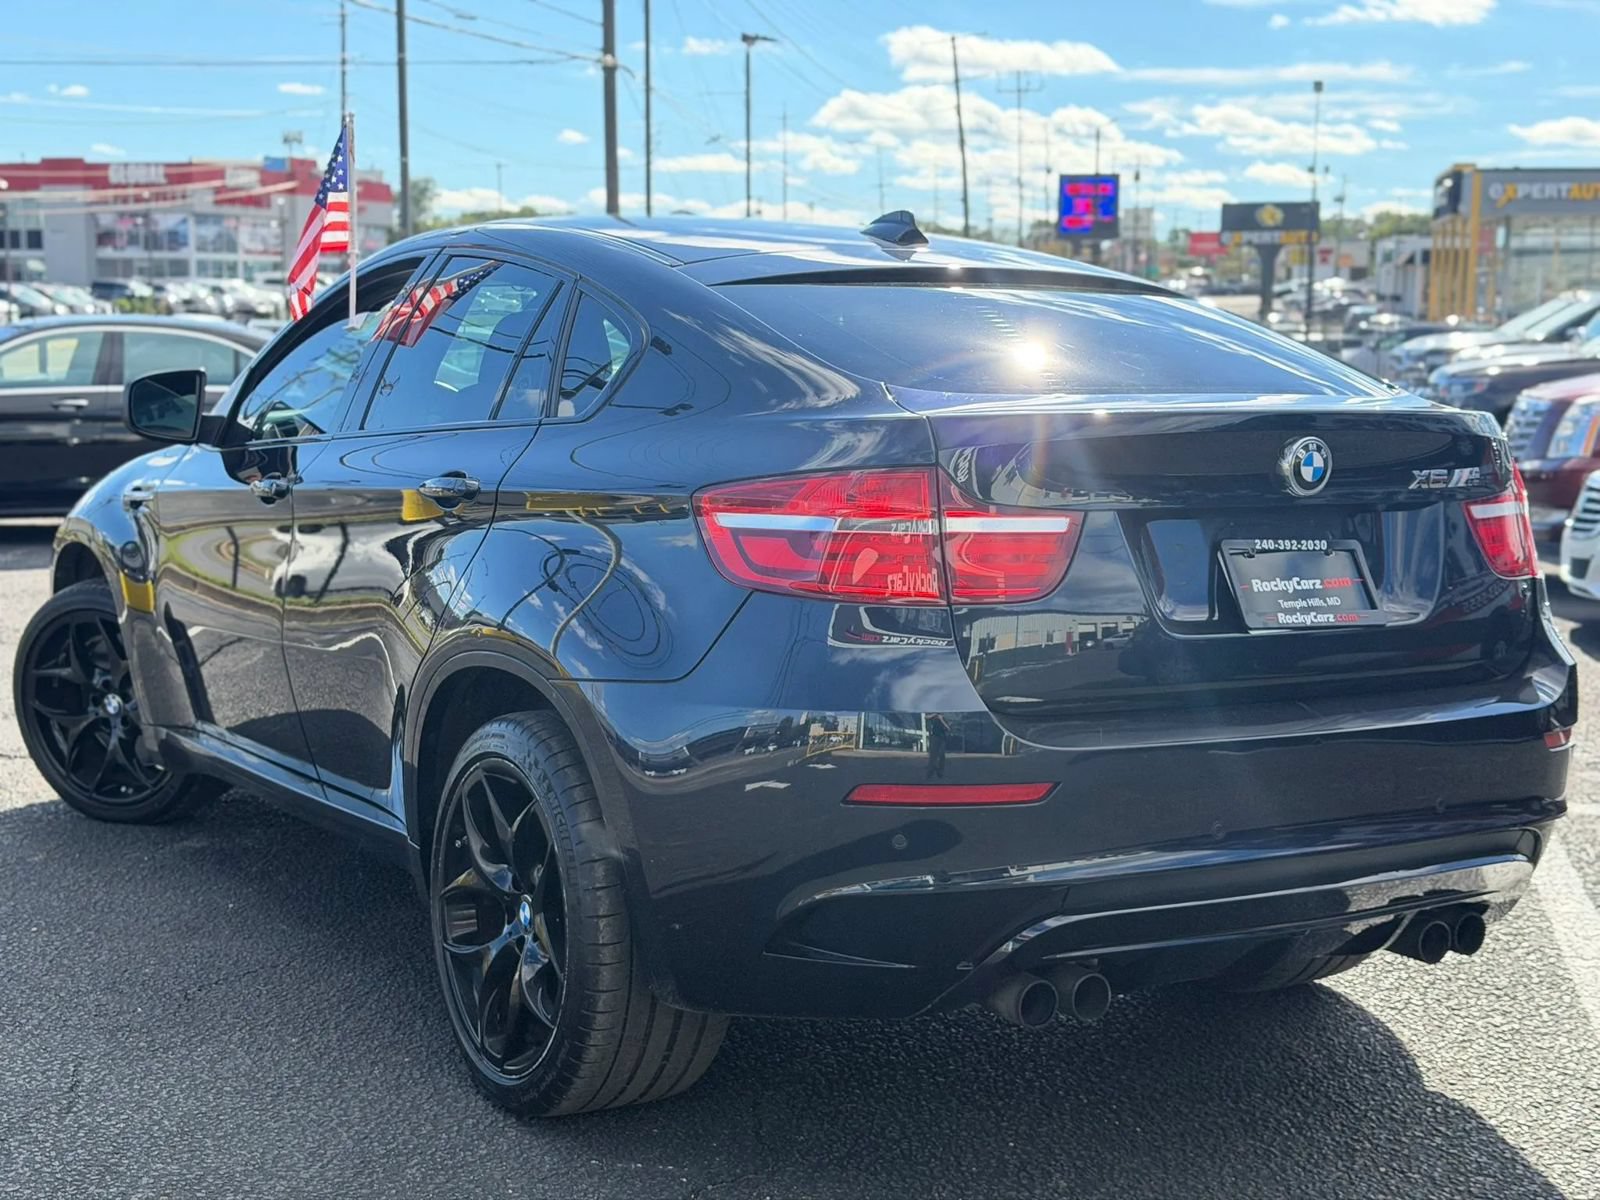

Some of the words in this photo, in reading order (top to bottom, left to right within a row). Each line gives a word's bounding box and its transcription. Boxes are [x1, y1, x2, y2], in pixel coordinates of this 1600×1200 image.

[1254, 539, 1328, 551] 240-392-2030
[1278, 598, 1307, 610] Temple
[1308, 598, 1327, 609] Hills,
[1327, 596, 1341, 606] MD
